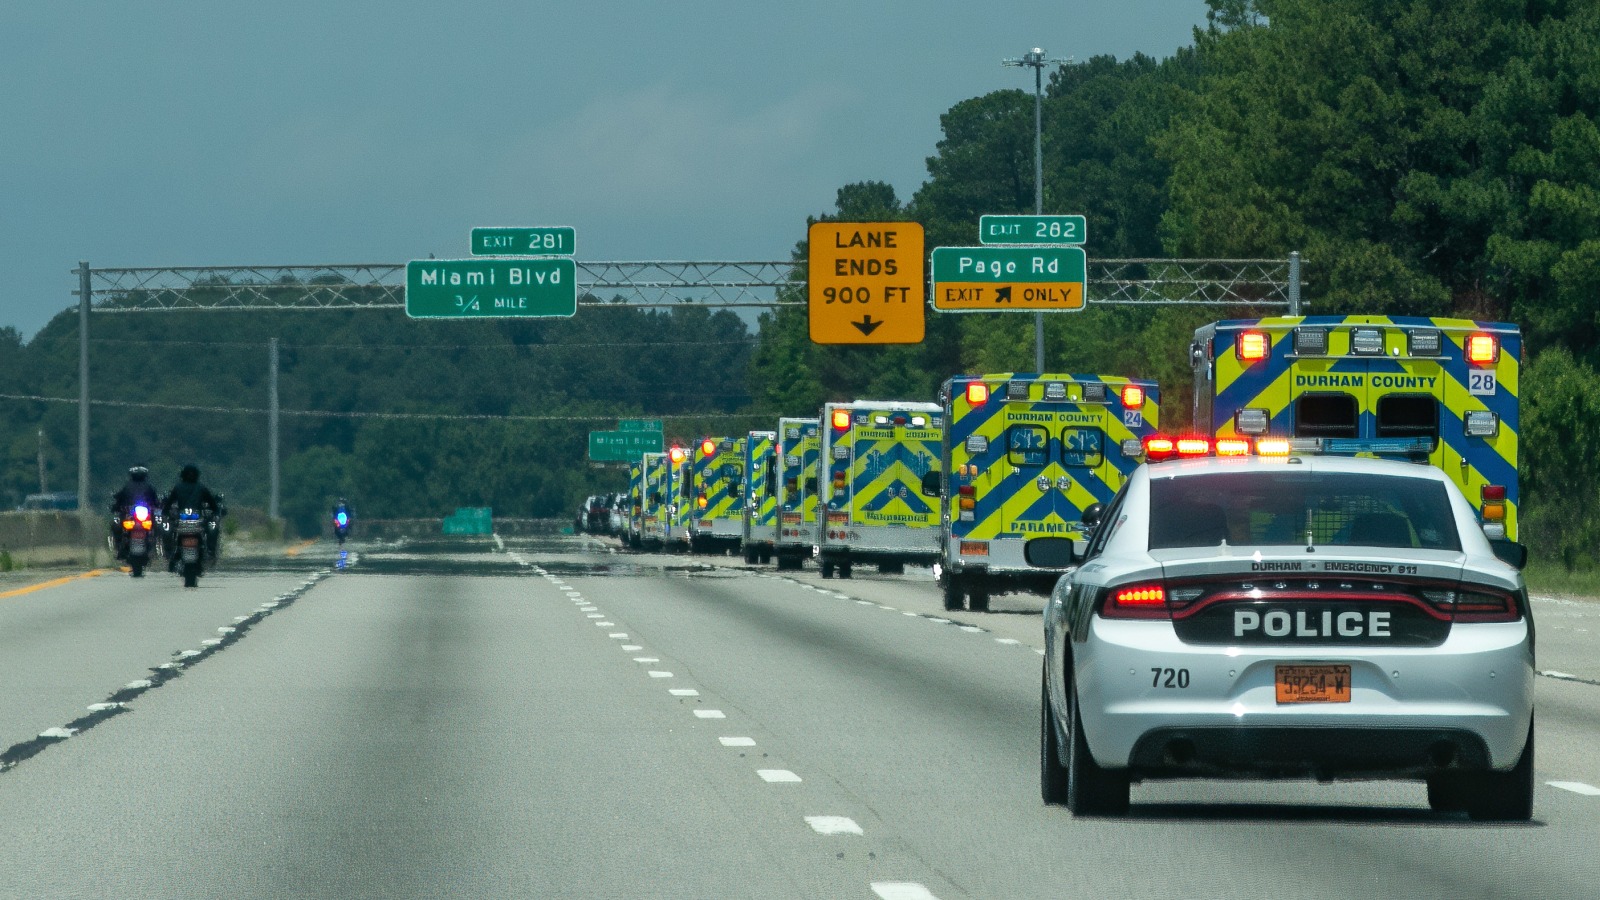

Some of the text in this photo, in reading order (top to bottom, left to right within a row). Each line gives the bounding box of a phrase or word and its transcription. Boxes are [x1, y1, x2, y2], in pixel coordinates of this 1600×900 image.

[989, 222, 1076, 238] EXIT 282
[483, 233, 563, 249] EXIT 281
[835, 231, 897, 249] LANE
[834, 258, 898, 276] ENDS
[959, 256, 1058, 278] Page Rd
[421, 267, 561, 286] Miami Blvd
[822, 286, 911, 304] 900 FT
[945, 287, 1072, 302] EXIT ONLY
[494, 297, 528, 309] MILE
[1295, 374, 1438, 389] DURHAM COUNTY
[1470, 374, 1494, 391] 28
[1007, 411, 1103, 423] DURHAM COUNTY
[1125, 410, 1142, 426] 24
[1010, 521, 1074, 533] PARAMED
[1251, 561, 1418, 575] DURHAM EMERGENCY 911
[1233, 609, 1391, 638] POLICE
[1150, 667, 1190, 689] 720
